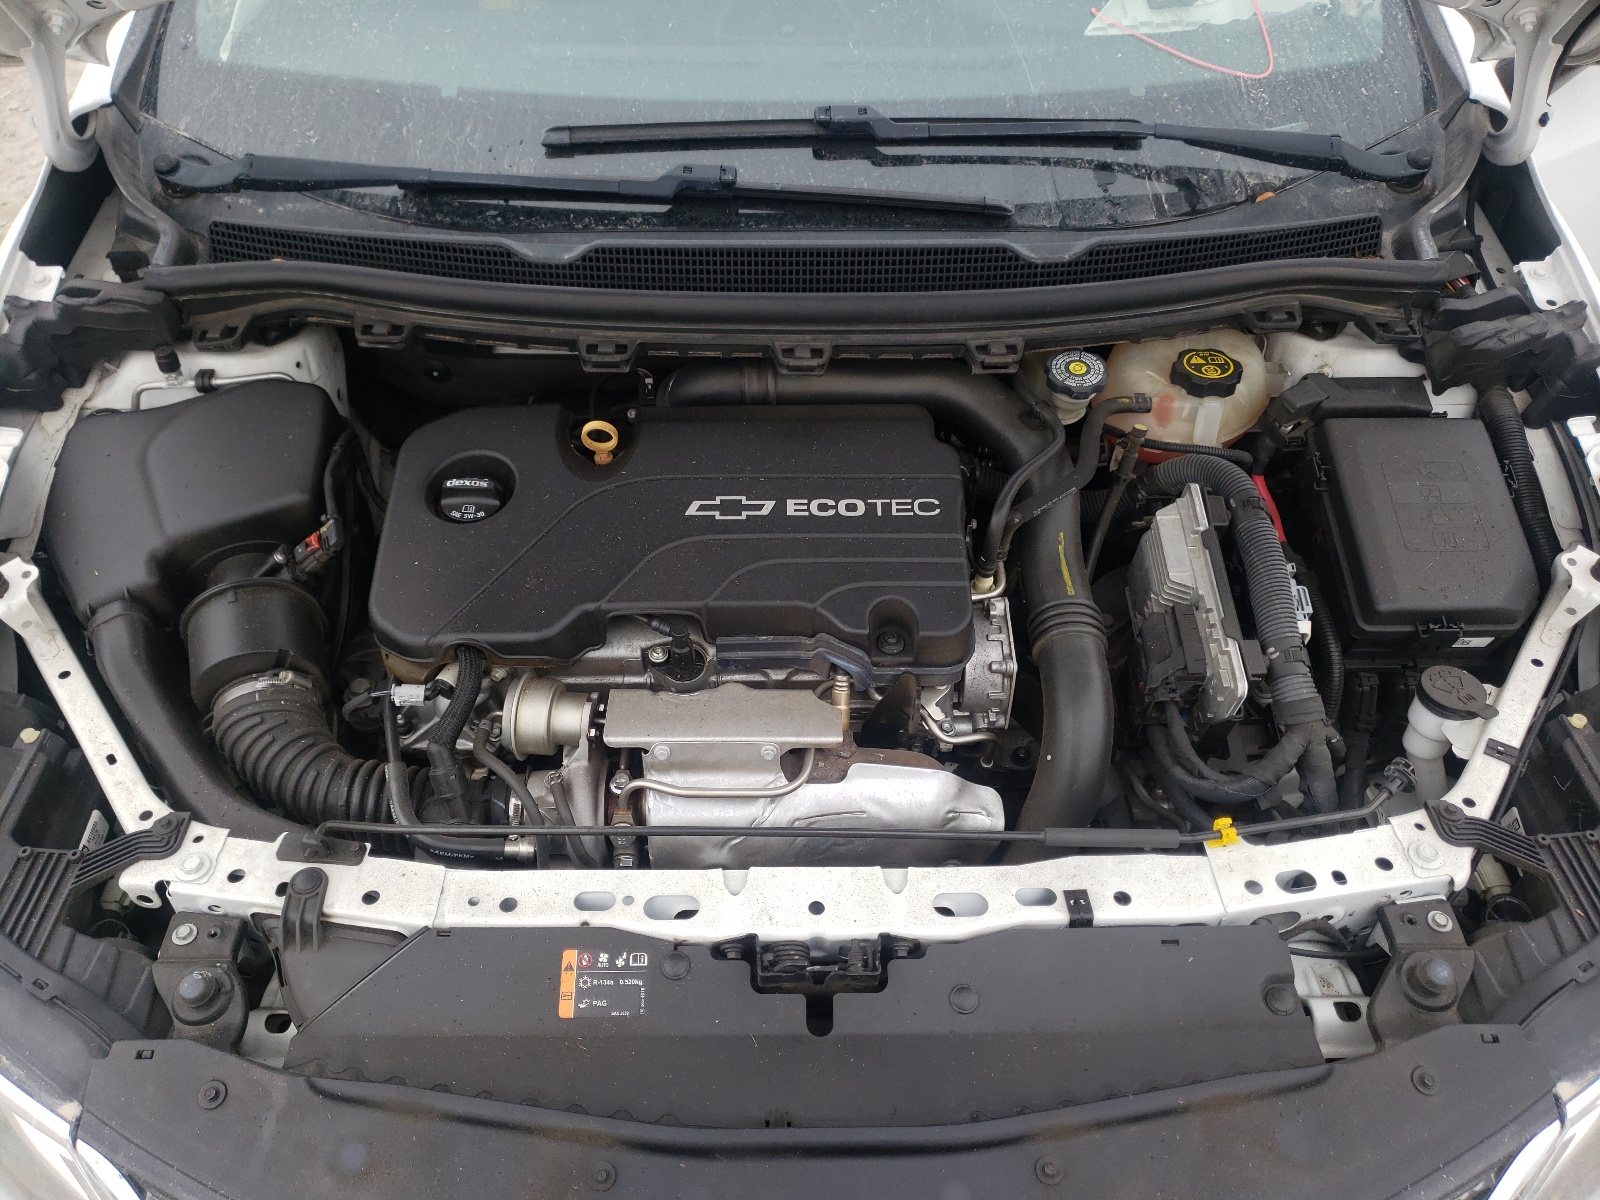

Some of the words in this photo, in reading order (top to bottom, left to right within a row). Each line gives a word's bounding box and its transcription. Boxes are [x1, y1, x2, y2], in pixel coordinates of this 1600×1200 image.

[446, 479, 488, 487] dexos
[786, 498, 941, 516] ECOTEC
[450, 510, 462, 518] SAE
[463, 511, 485, 519] 5W-30
